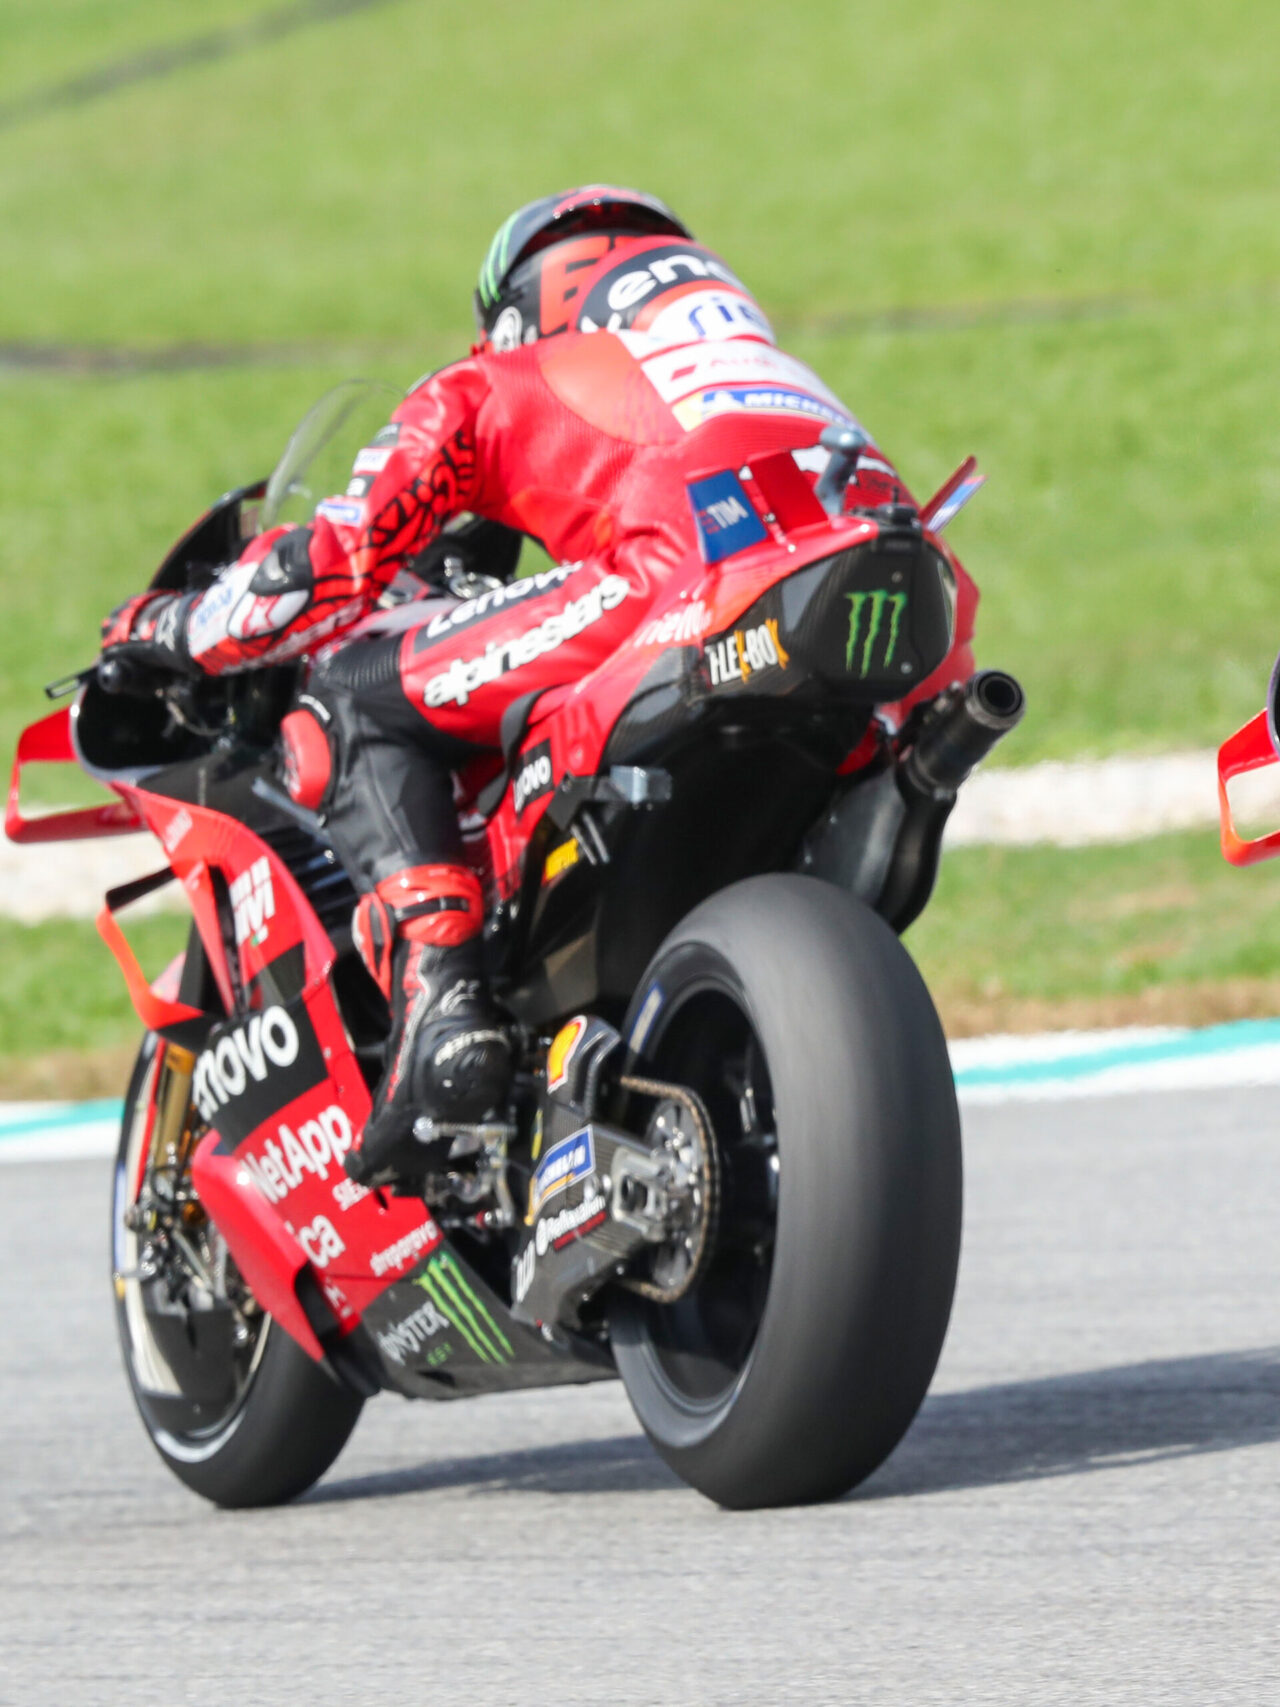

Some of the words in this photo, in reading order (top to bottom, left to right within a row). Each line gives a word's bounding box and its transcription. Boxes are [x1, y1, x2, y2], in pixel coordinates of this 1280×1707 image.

[423, 573, 631, 708] alpinestars
[193, 1004, 300, 1122] novo
[239, 1104, 353, 1205] NetApp
